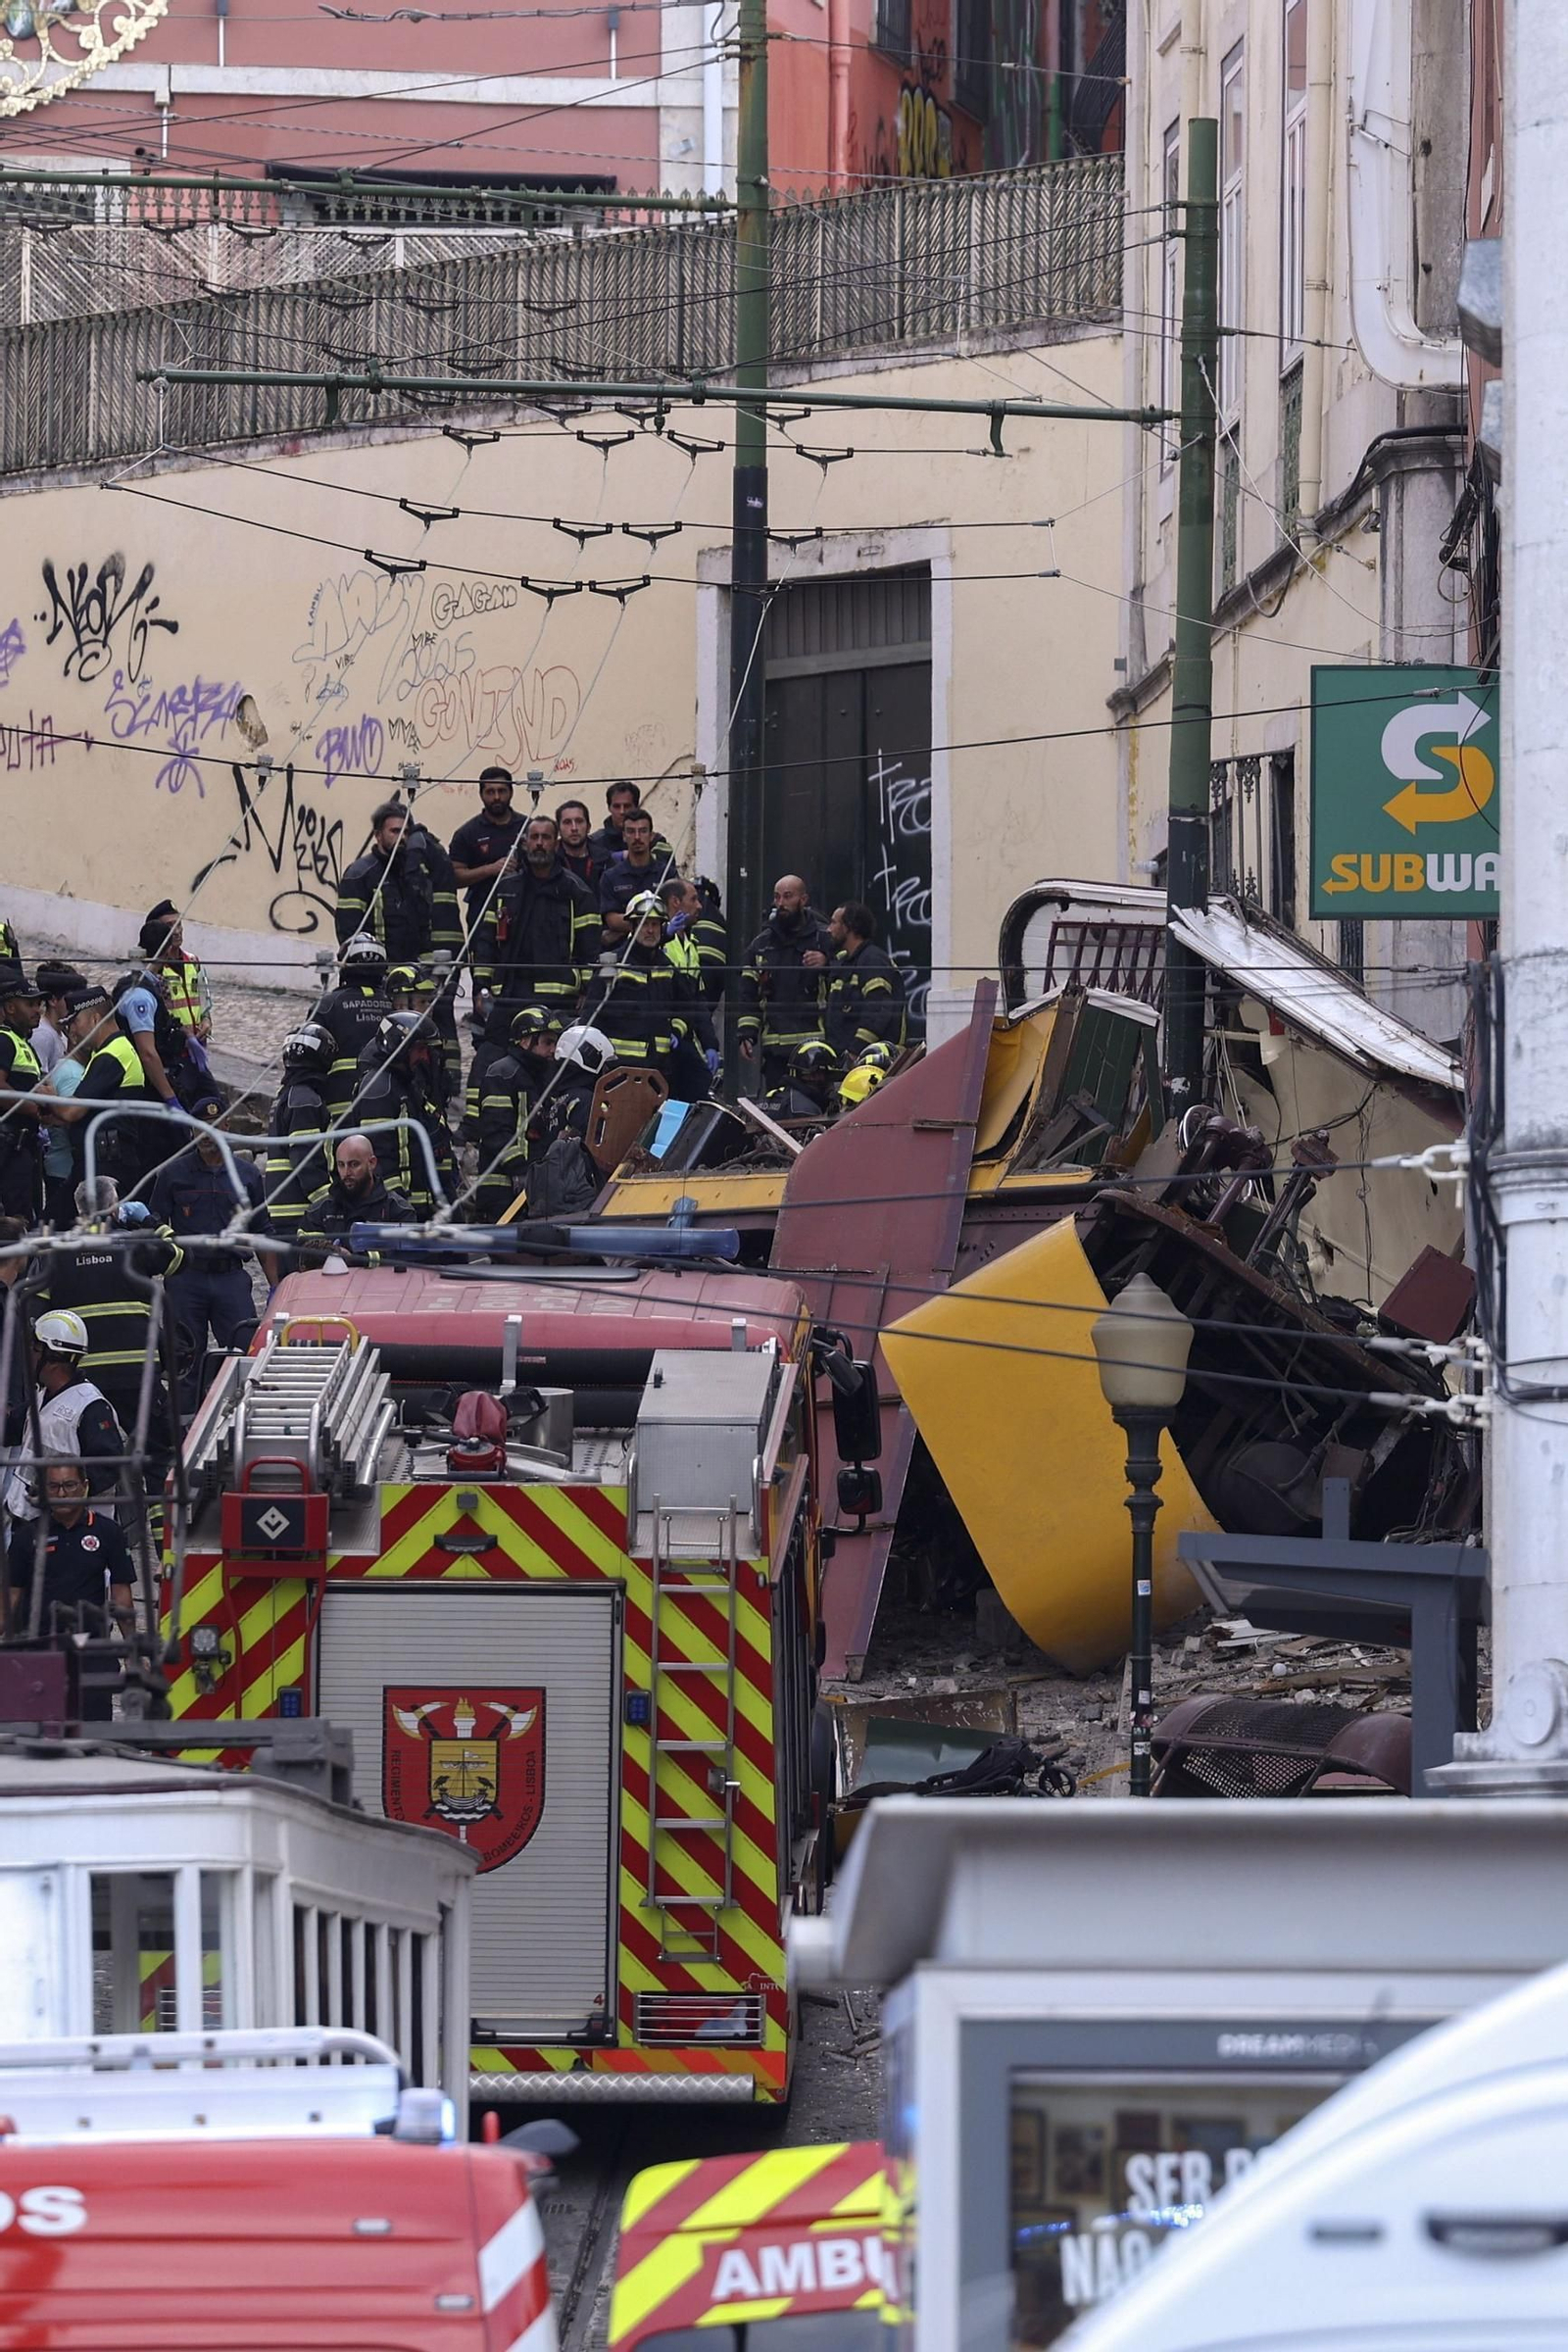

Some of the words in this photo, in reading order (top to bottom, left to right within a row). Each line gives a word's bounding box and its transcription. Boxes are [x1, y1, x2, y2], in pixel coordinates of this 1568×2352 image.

[431, 581, 517, 630] GAGAN
[1321, 853, 1500, 895] SUBWA
[342, 1001, 392, 1009] SAPADORE
[356, 1013, 383, 1022] Lisbo
[75, 1255, 113, 1266] Lisboa
[391, 1749, 405, 1821] REGIMENTO
[483, 1804, 533, 1861] BOMBEIROS
[525, 1750, 536, 1794] LISBOA
[594, 1993, 604, 2006] 4
[0, 2185, 87, 2236] S
[710, 2235, 899, 2301] AMBU
